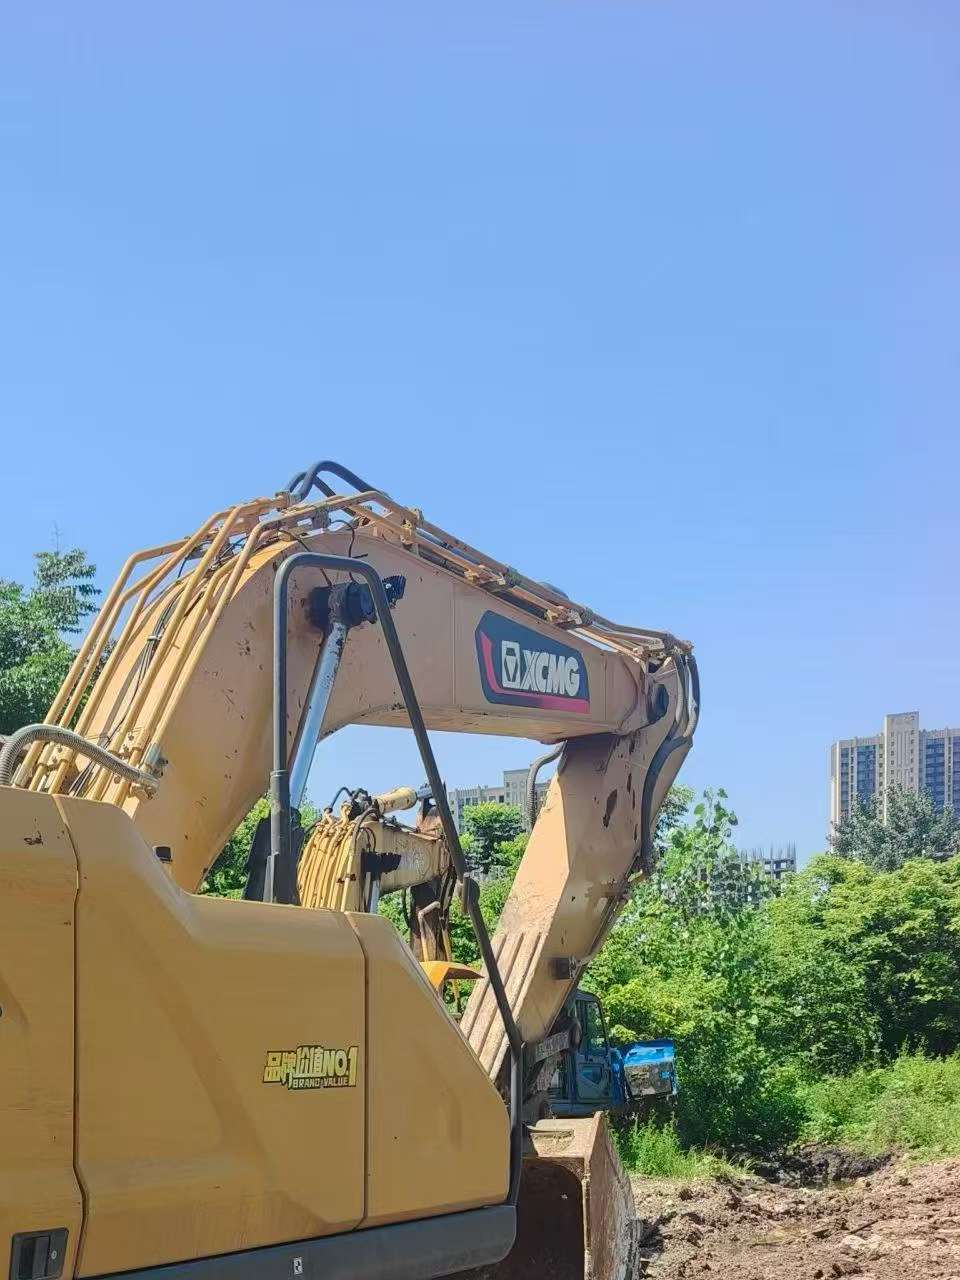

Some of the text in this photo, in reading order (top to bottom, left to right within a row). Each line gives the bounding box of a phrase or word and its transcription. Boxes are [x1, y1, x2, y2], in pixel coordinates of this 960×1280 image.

[520, 650, 580, 697] XCMG
[292, 1077, 349, 1088] BRAND VALUE
